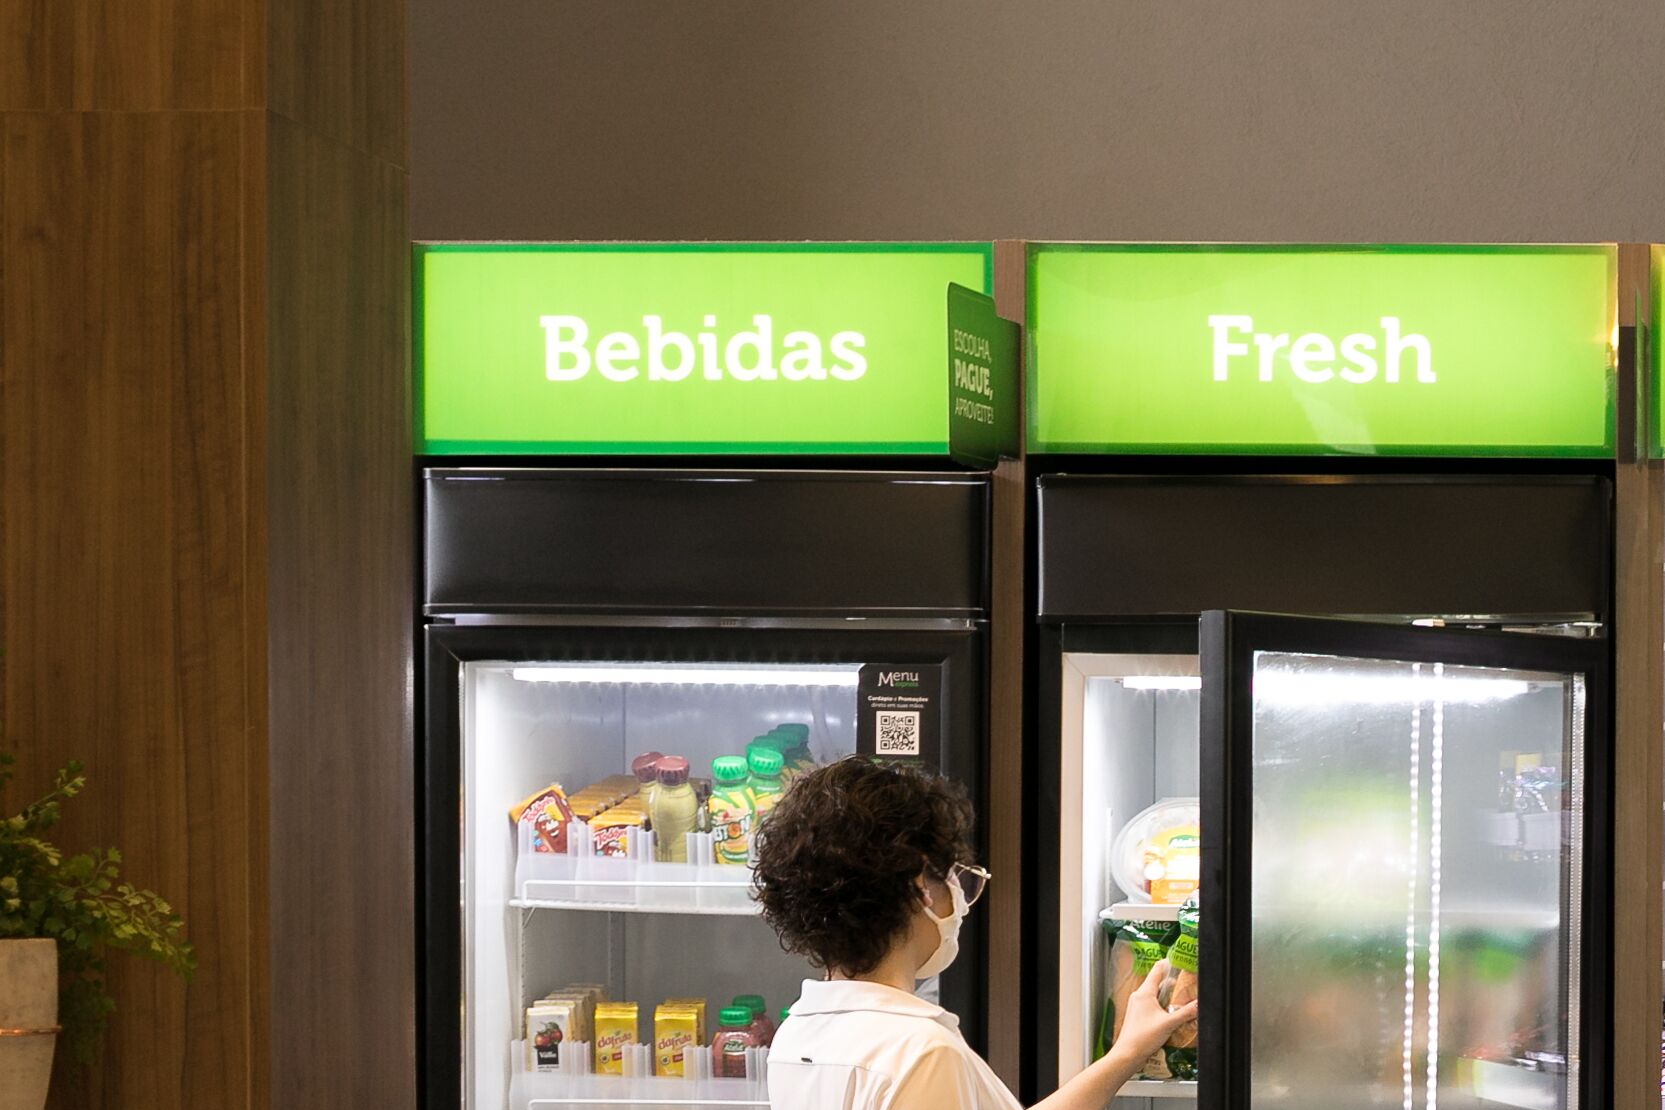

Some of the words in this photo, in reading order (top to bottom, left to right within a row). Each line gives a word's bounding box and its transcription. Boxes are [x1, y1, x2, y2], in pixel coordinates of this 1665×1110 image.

[540, 315, 867, 382] Bebidas
[954, 328, 992, 364] ESCOLHA,
[1208, 315, 1436, 384] Fresh
[954, 358, 993, 401] PAGUE,
[877, 671, 919, 687] Menu
